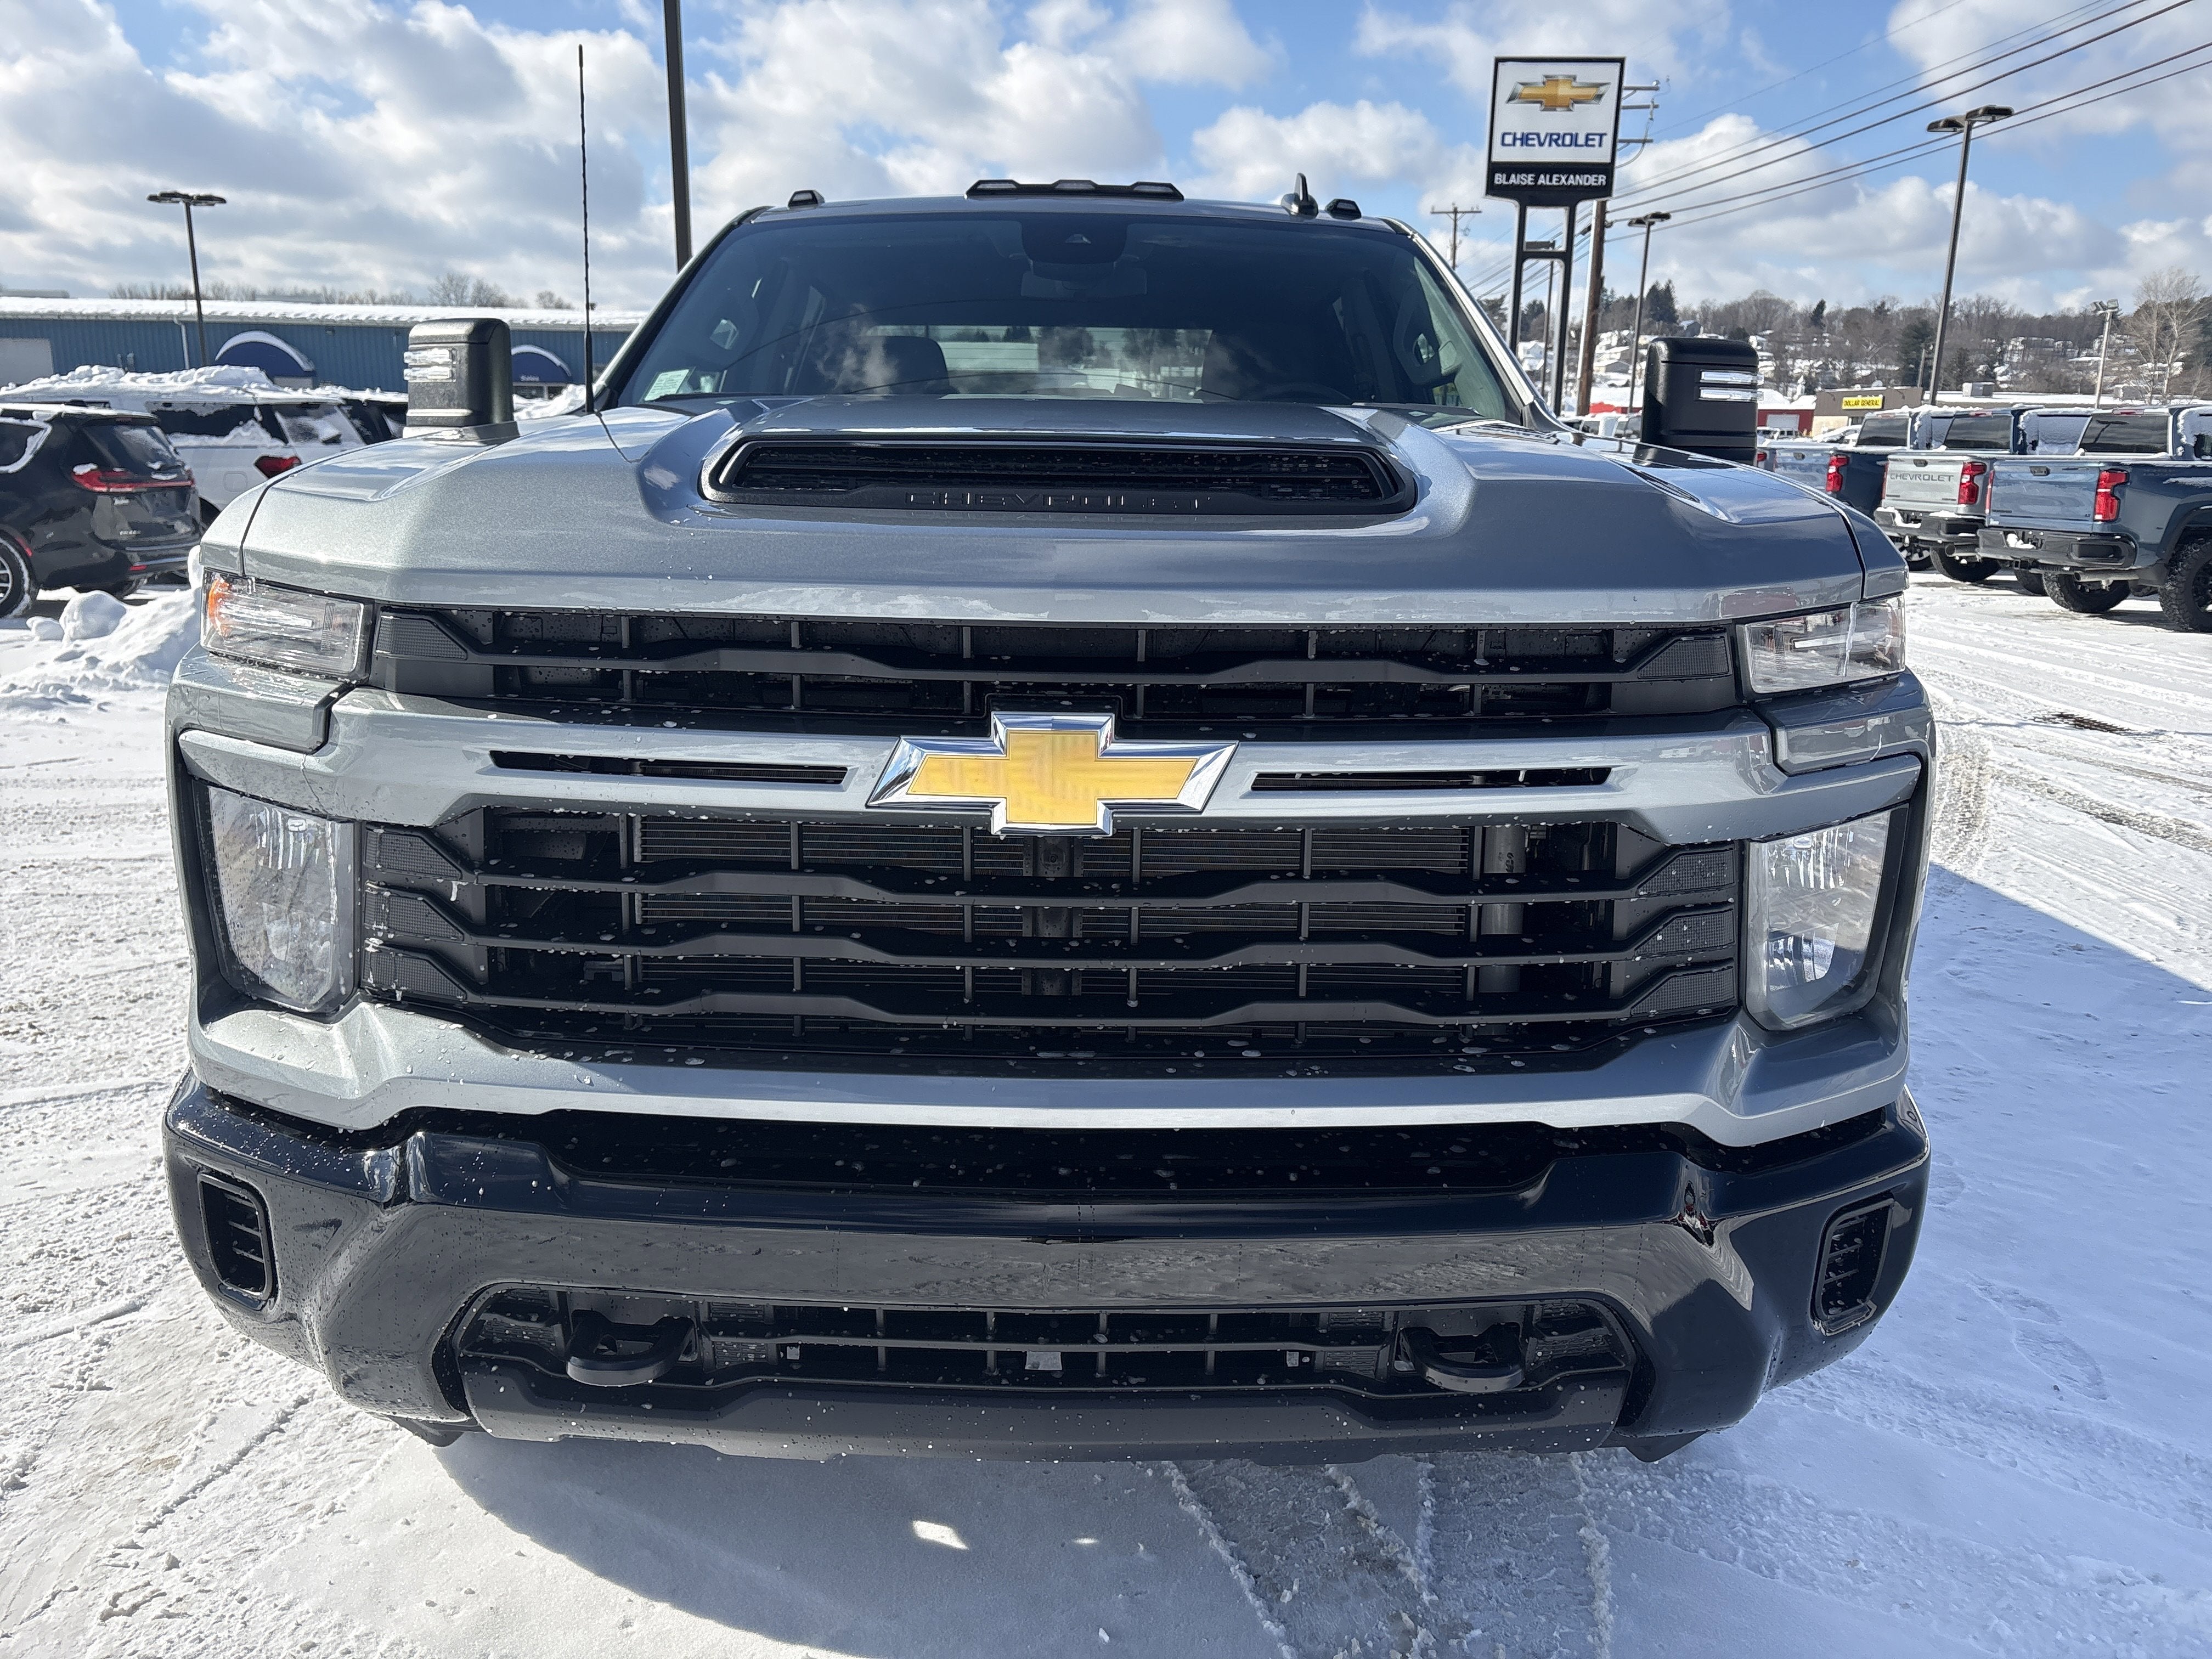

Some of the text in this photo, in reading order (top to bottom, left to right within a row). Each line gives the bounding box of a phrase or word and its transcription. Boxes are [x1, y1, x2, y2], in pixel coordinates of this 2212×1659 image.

[1500, 132, 1607, 148] CHEVROLET
[1494, 173, 1606, 186] BLAISE ALEXANDER
[1890, 472, 1954, 482] CHEVROLET
